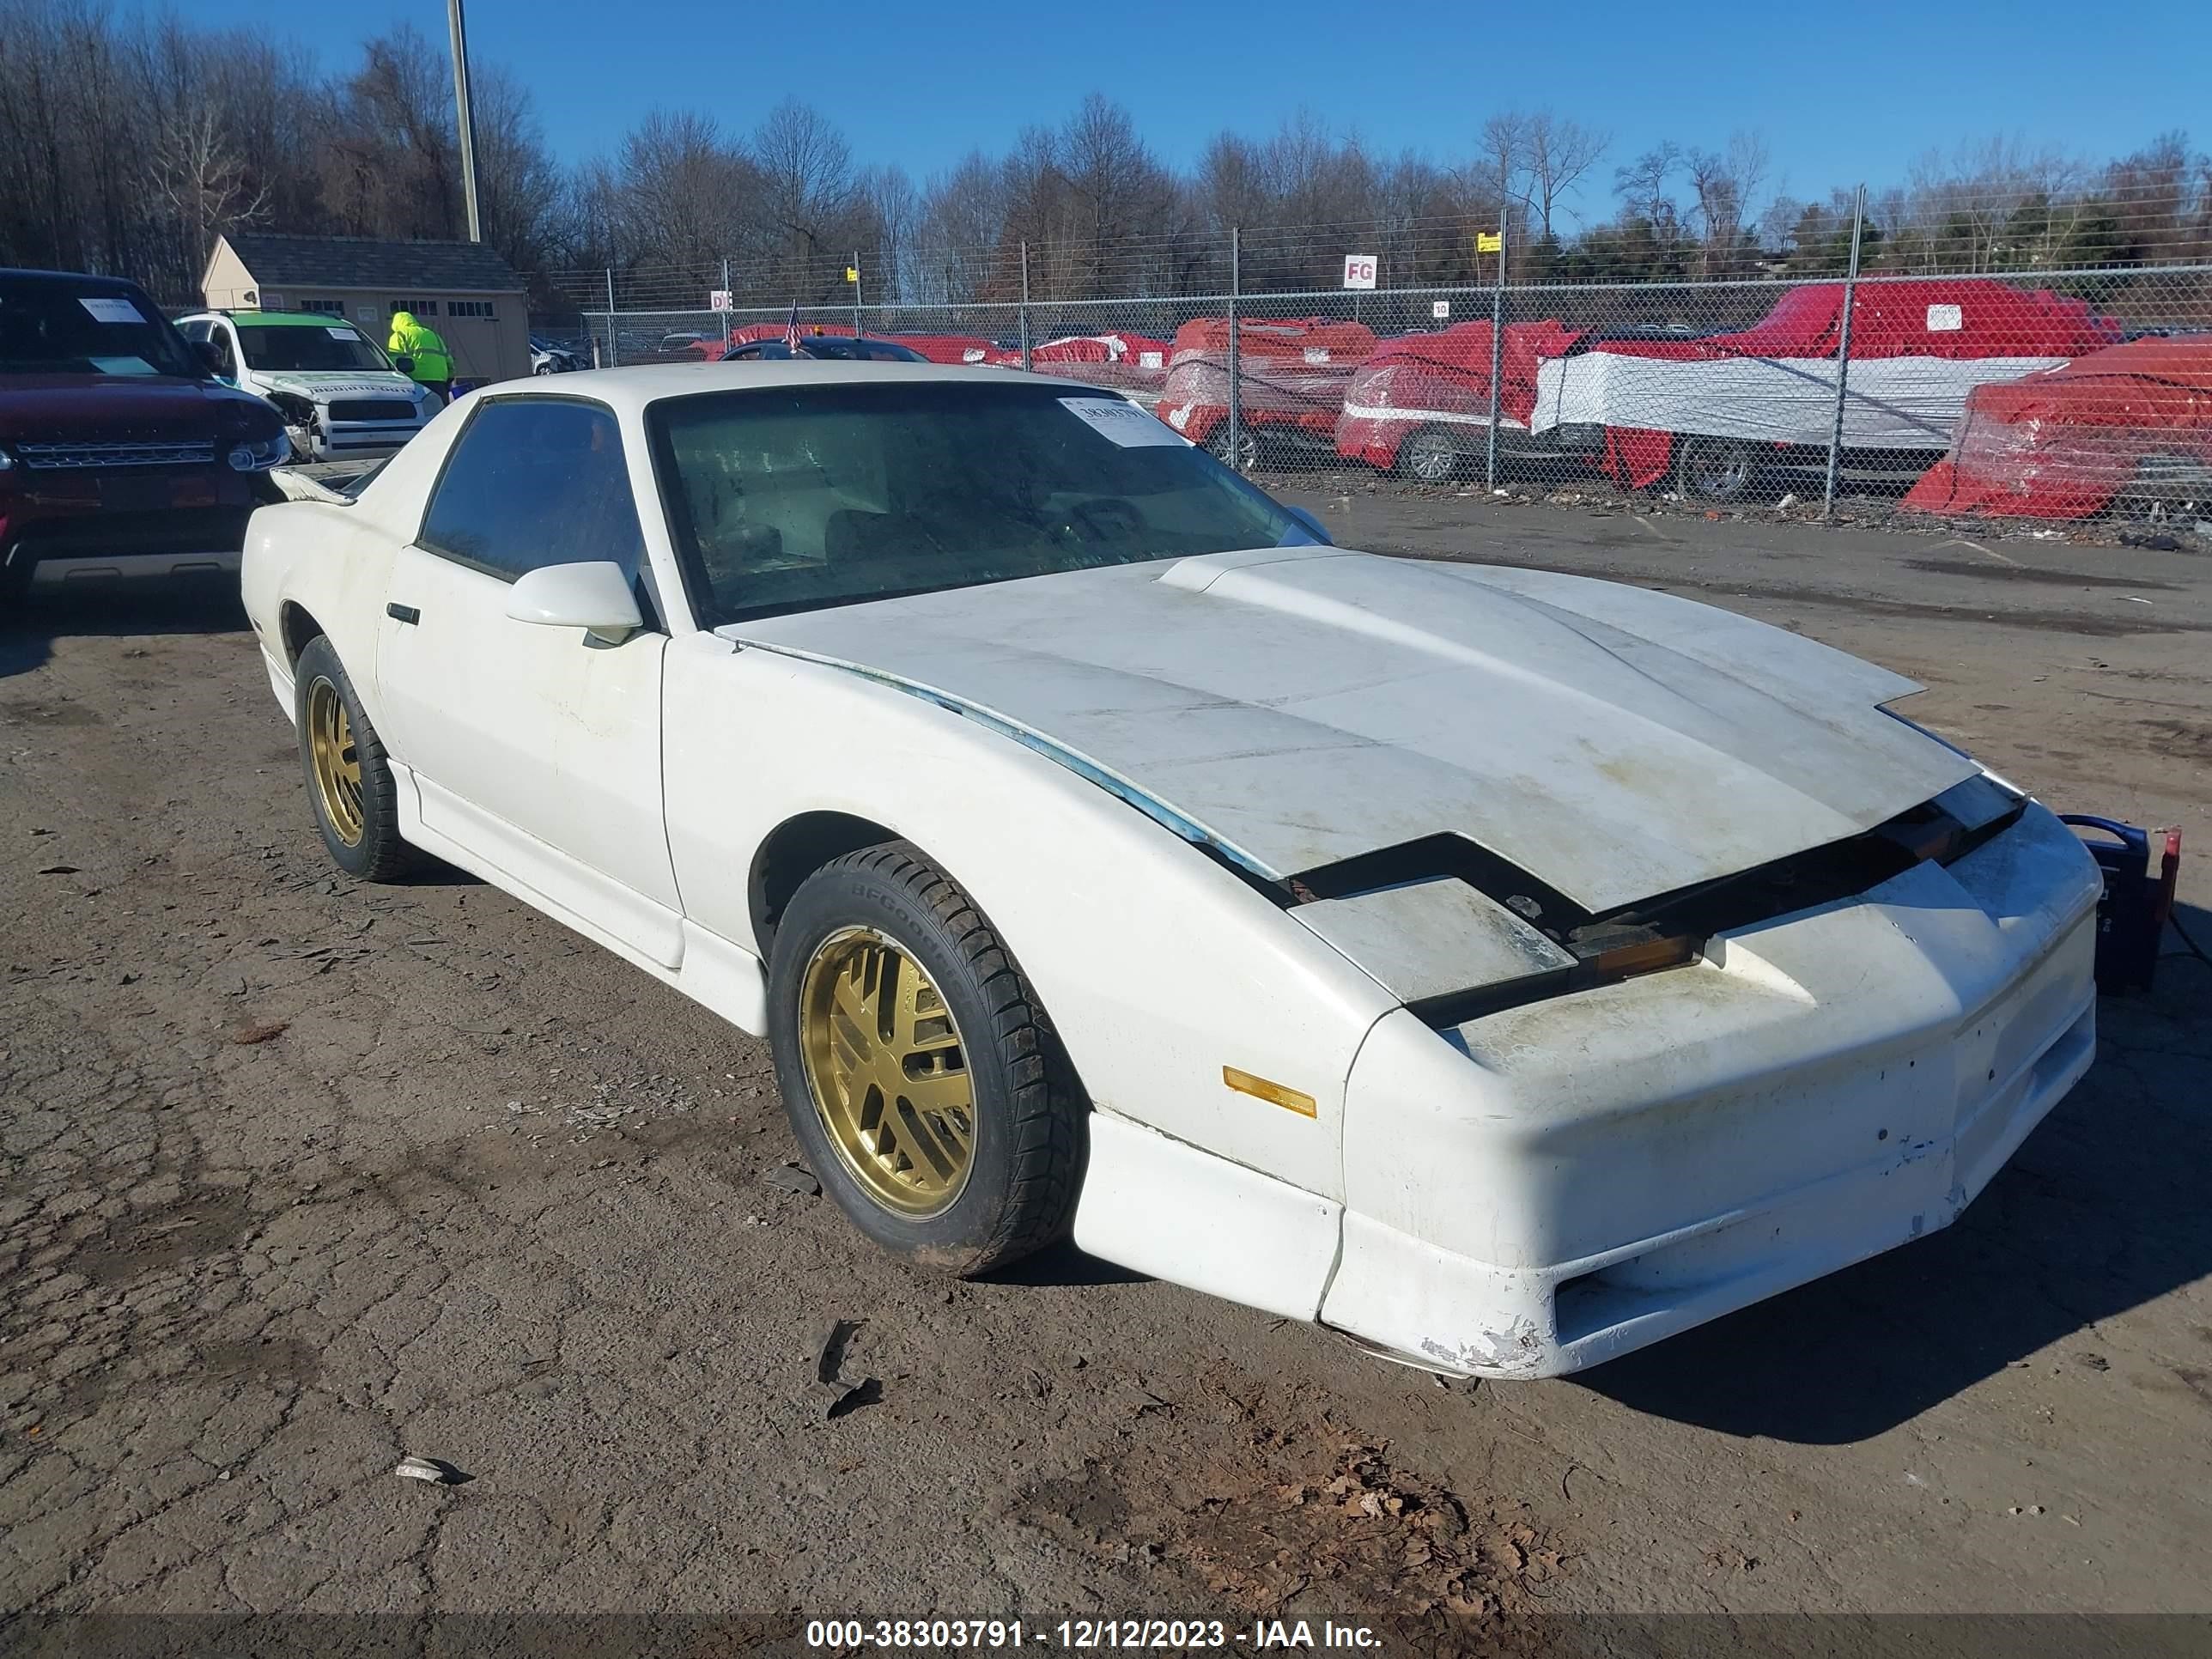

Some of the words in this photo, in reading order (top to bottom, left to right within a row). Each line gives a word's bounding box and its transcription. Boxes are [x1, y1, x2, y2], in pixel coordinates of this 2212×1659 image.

[1348, 263, 1373, 280] FG
[1436, 305, 1446, 313] 10
[1079, 408, 1146, 419] 38303791
